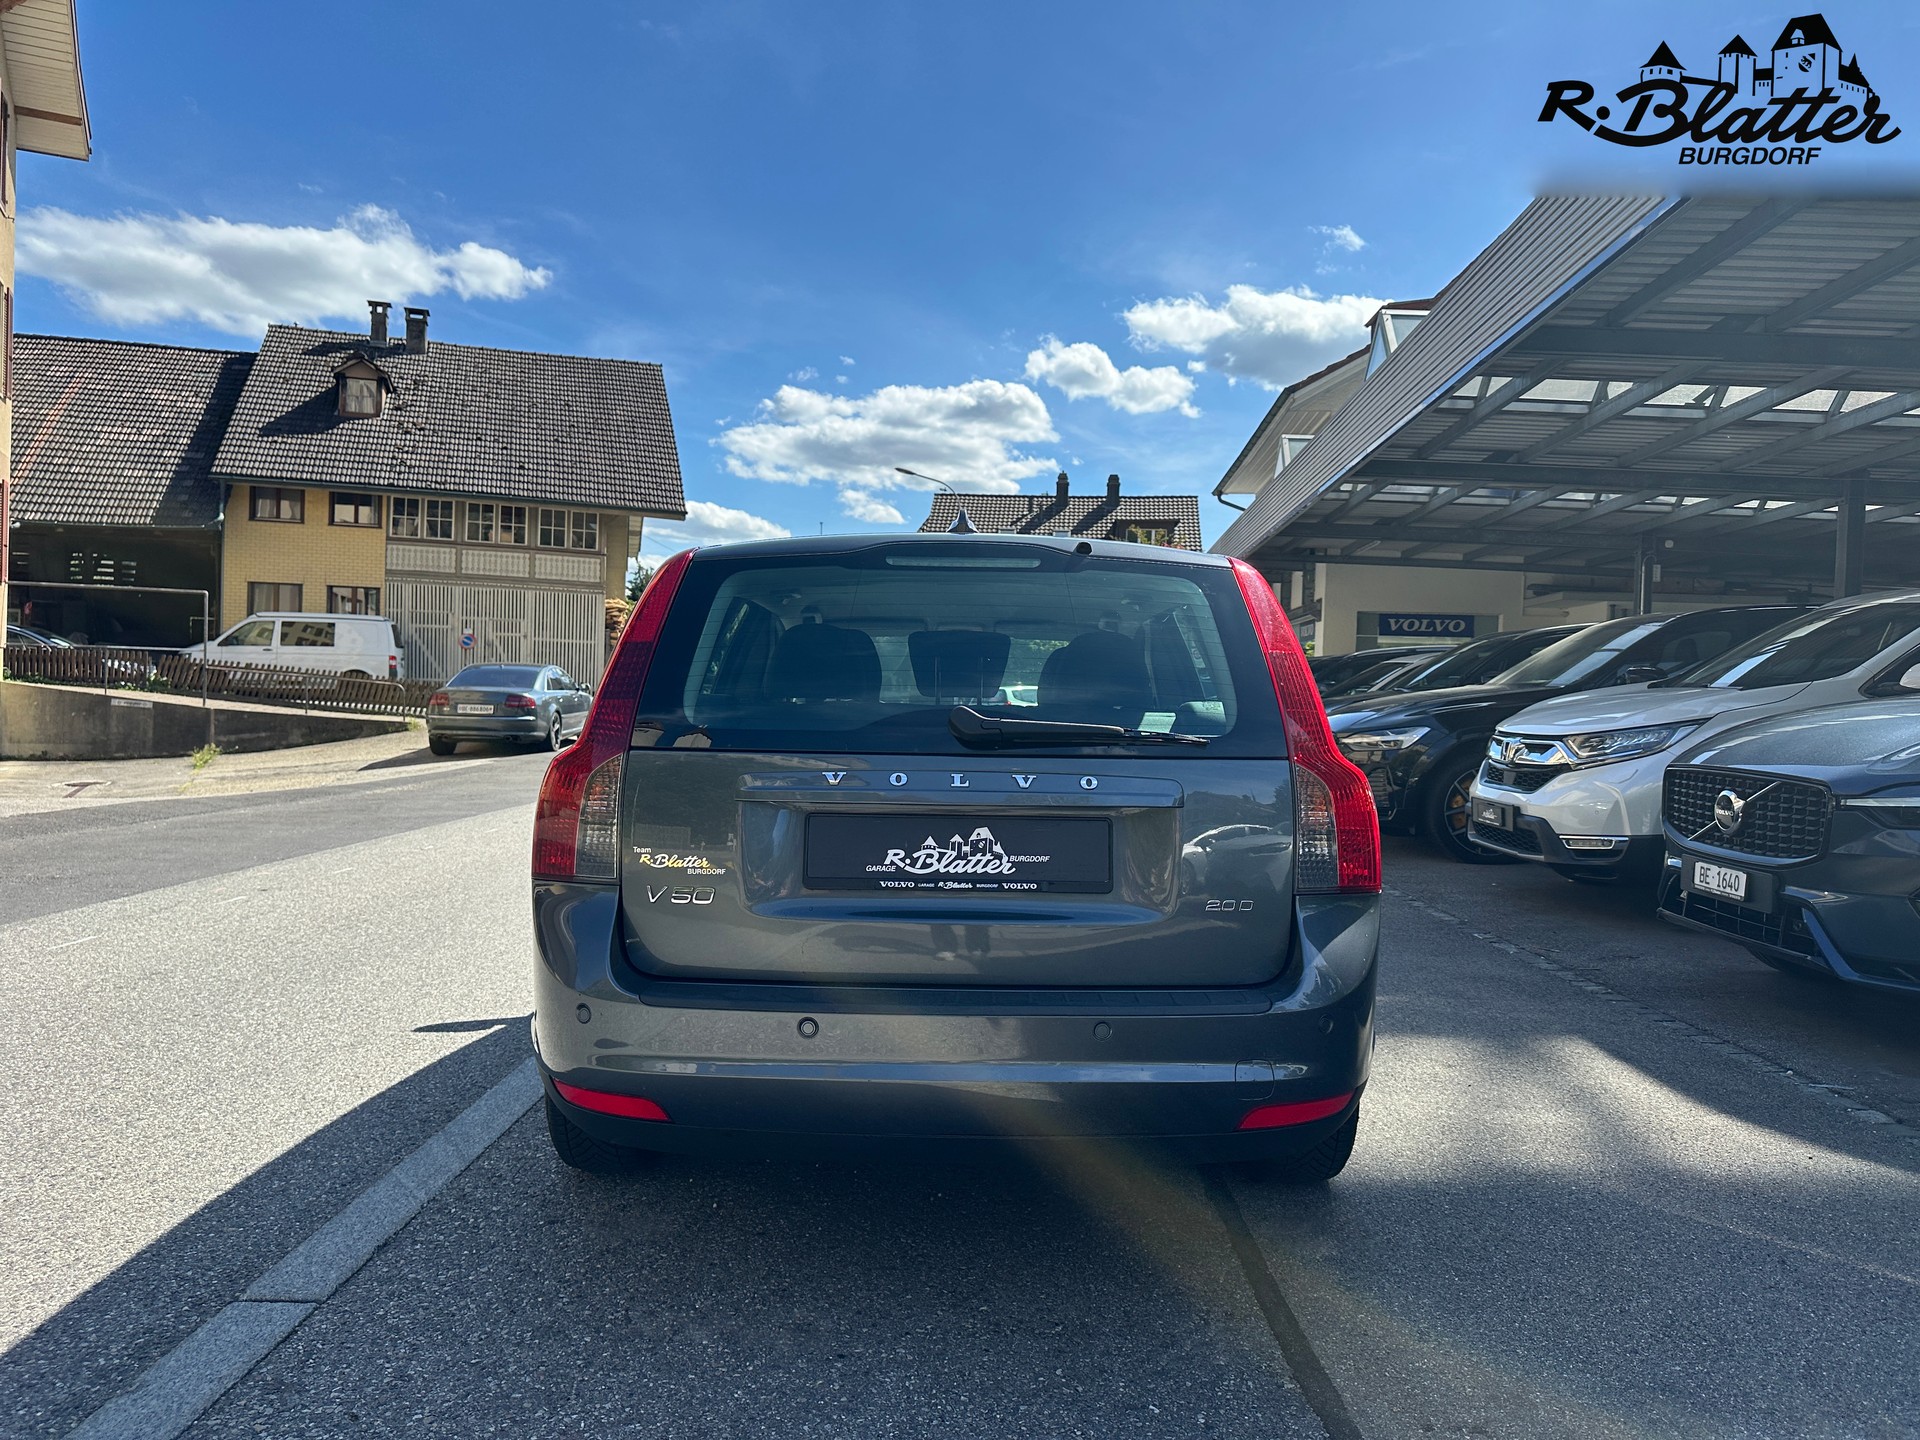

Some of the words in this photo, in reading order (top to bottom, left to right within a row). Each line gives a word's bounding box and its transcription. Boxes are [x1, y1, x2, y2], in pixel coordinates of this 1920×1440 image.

[1388, 618, 1466, 633] VOLVO
[822, 772, 1098, 790] VOLVO
[633, 846, 652, 854] Team
[865, 864, 897, 872] GARAGE
[1009, 855, 1051, 863] BURGDORF
[879, 880, 915, 888] VOLVO
[1001, 882, 1038, 890] VOLVO
